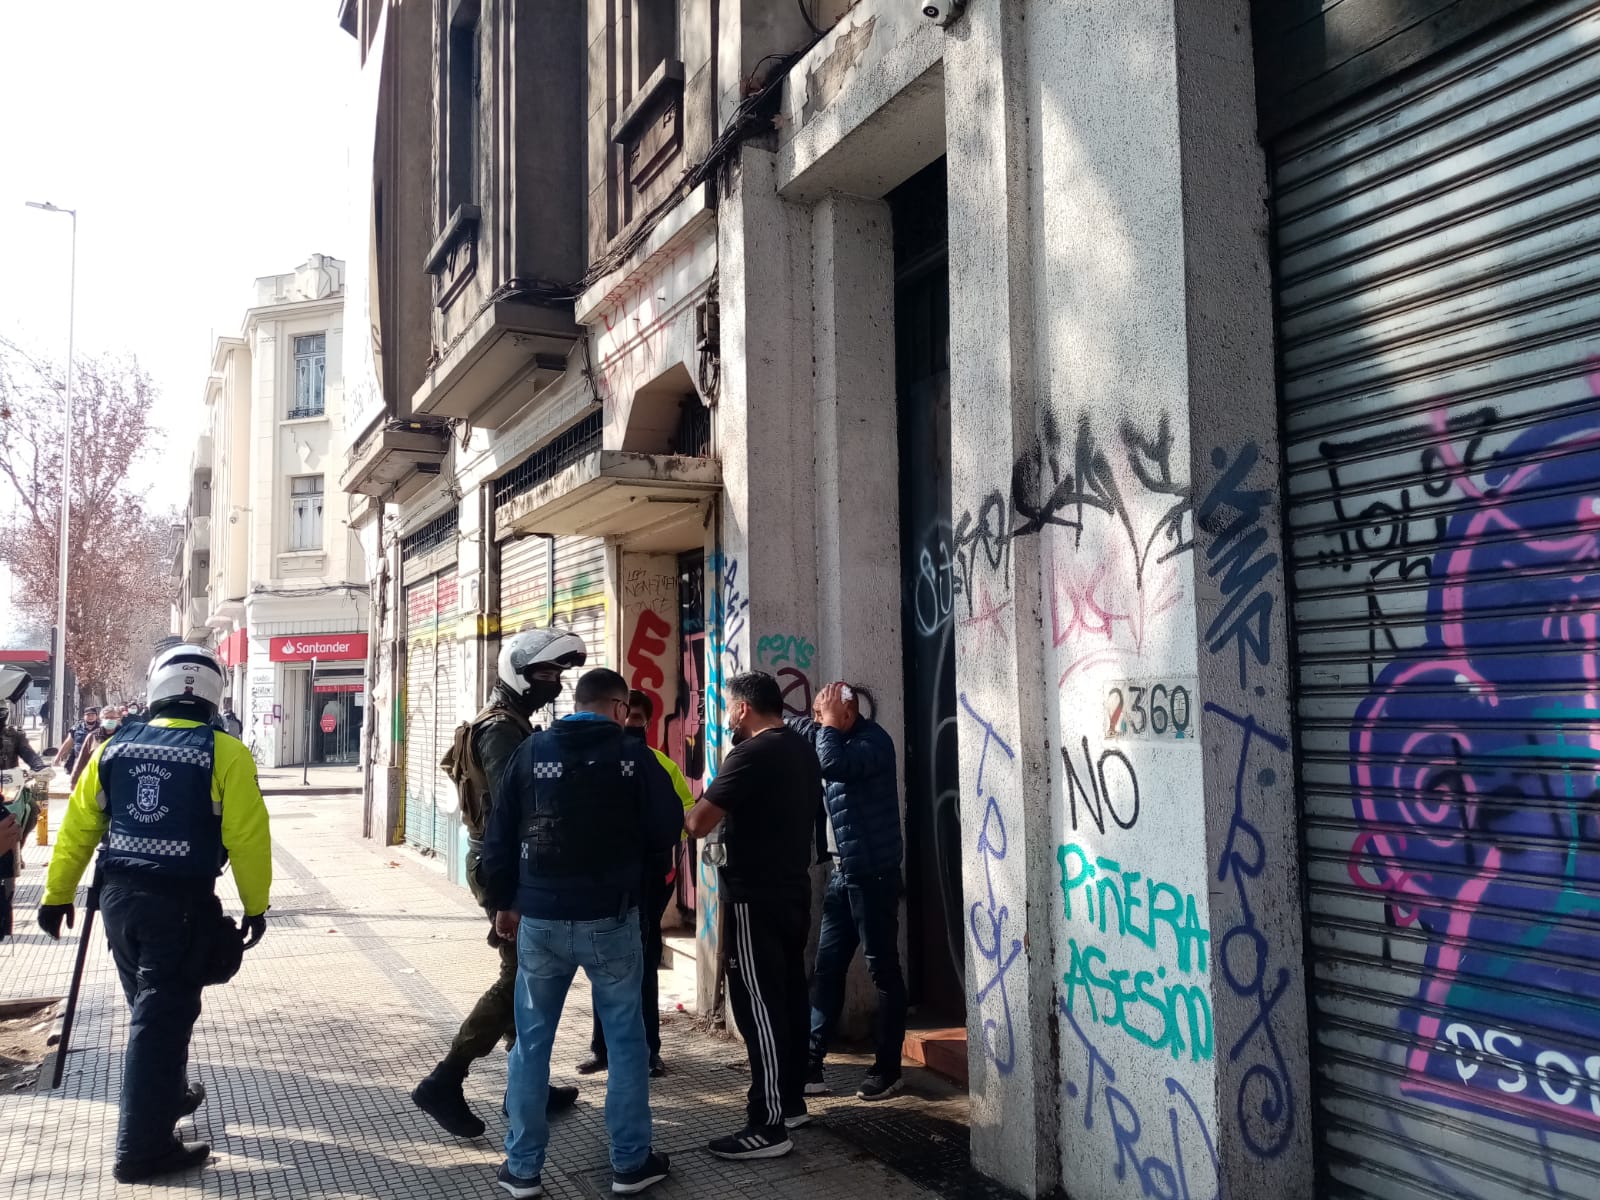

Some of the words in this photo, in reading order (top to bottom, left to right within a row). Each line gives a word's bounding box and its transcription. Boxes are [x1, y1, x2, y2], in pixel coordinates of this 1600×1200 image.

[296, 641, 350, 654] Santander
[1105, 683, 1190, 740] 2360
[128, 762, 172, 780] SANTIAGO
[1061, 735, 1140, 835] NO
[126, 802, 169, 823] SEGURIDAD
